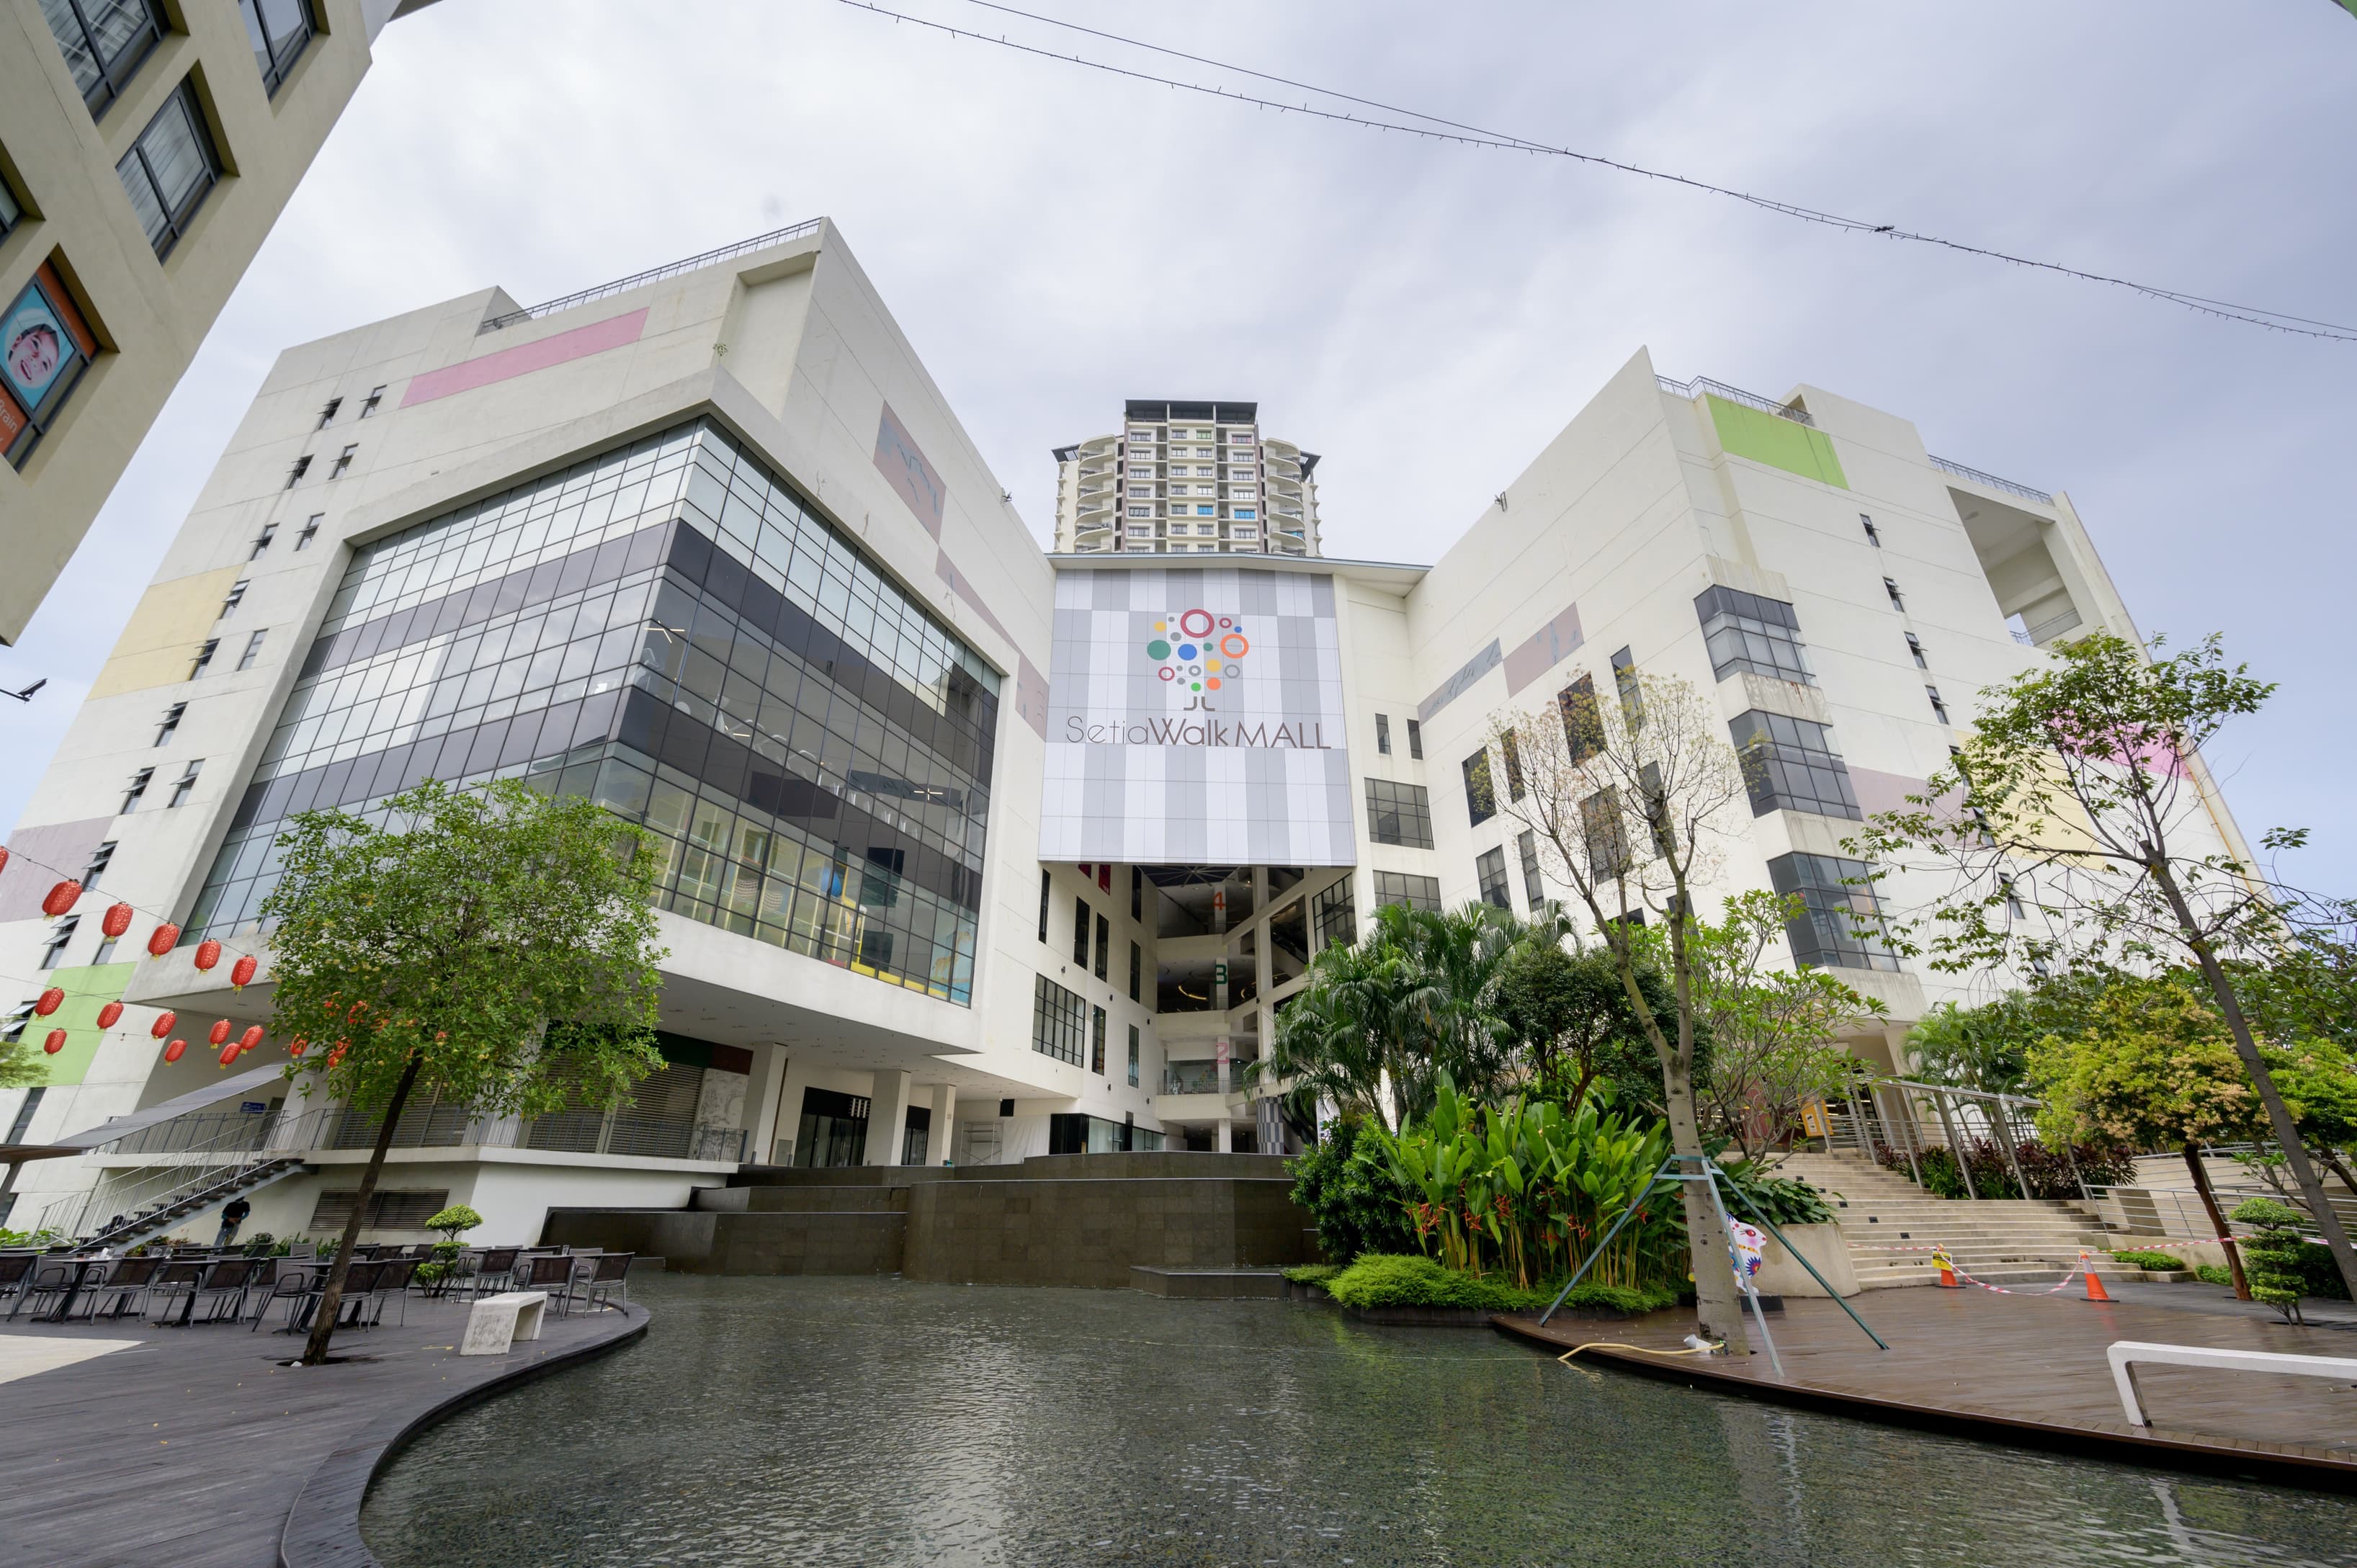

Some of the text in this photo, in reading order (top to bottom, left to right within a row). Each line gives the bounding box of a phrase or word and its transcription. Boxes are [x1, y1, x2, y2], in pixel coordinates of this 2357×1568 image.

[1235, 720, 1332, 750] MALL
[1212, 892, 1226, 911] 4
[1214, 964, 1227, 985] 3
[1216, 1042, 1229, 1064] 2
